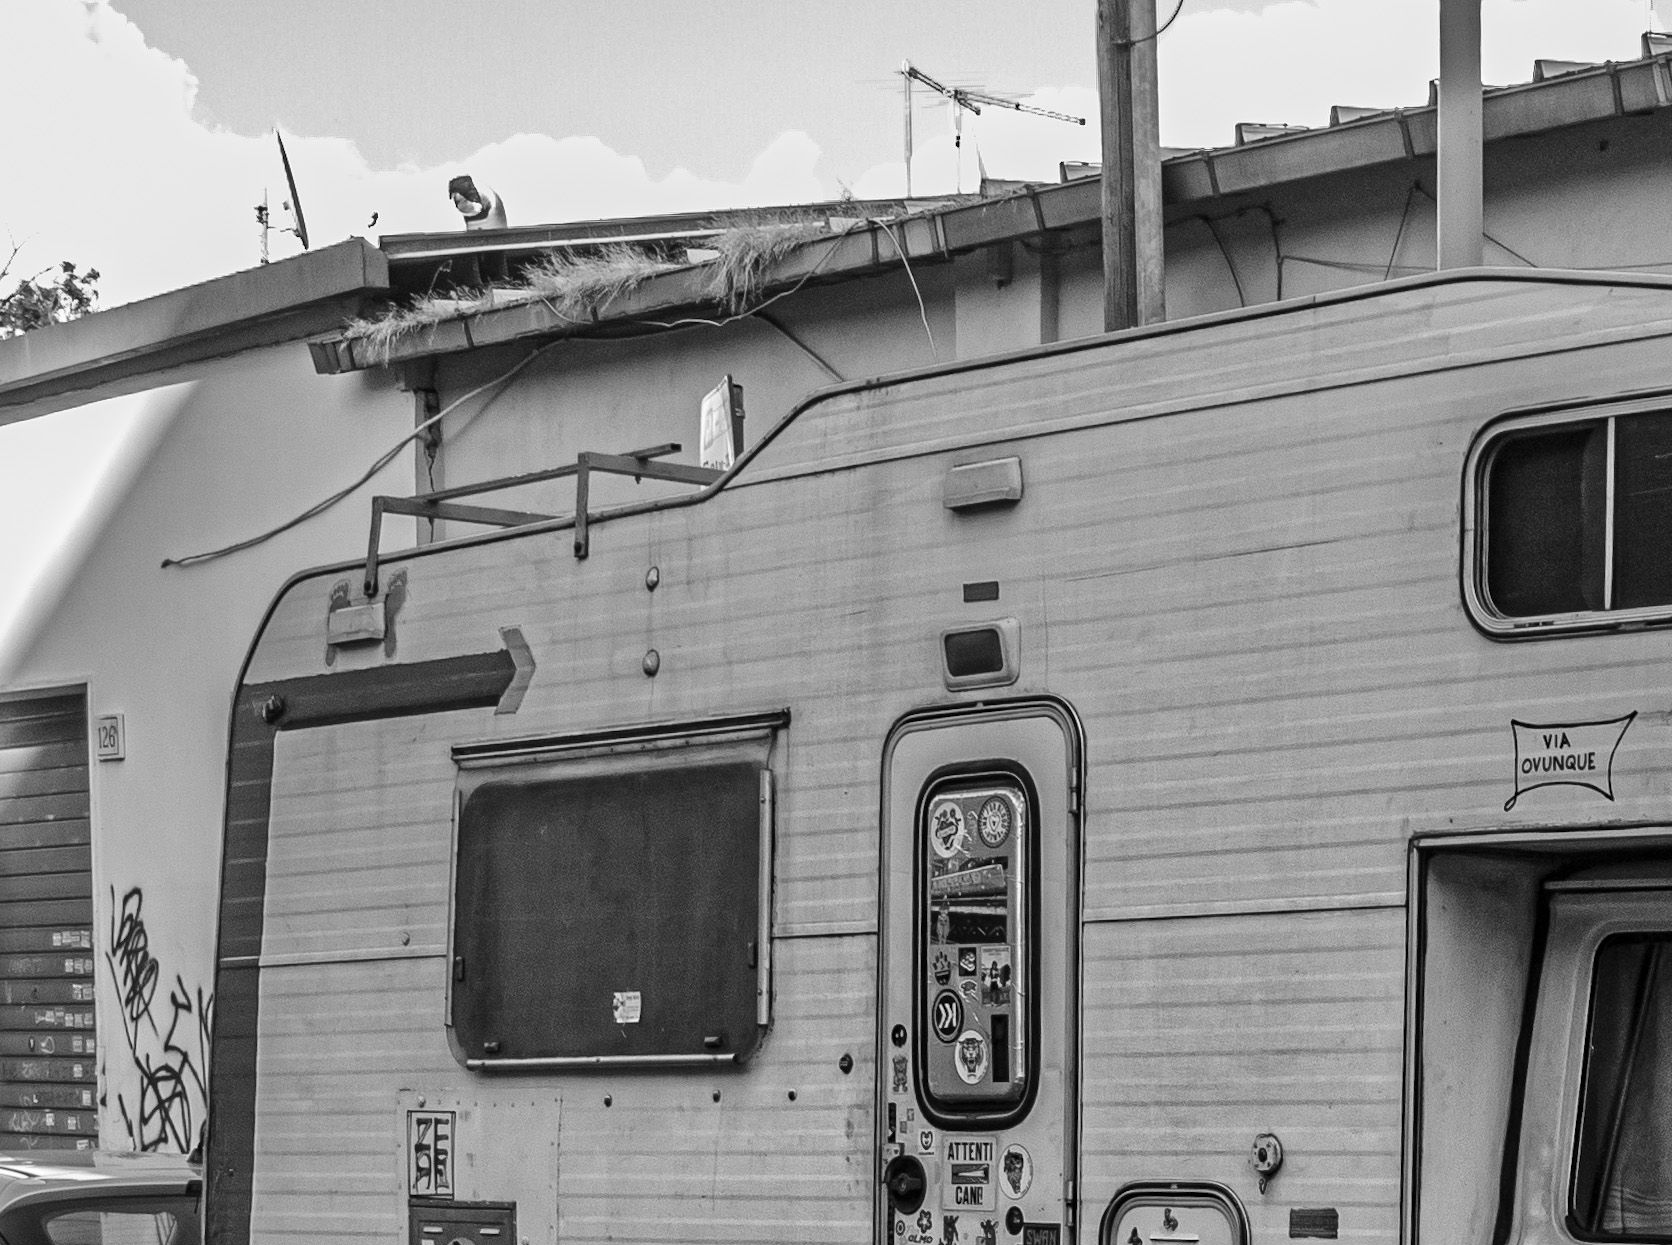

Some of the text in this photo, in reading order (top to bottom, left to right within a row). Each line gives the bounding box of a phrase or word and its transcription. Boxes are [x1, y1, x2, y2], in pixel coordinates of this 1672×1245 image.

[98, 725, 116, 749] 126
[1542, 732, 1571, 749] VIA
[1521, 751, 1597, 774] OVUNQUE
[947, 1142, 993, 1161] ATTENTI
